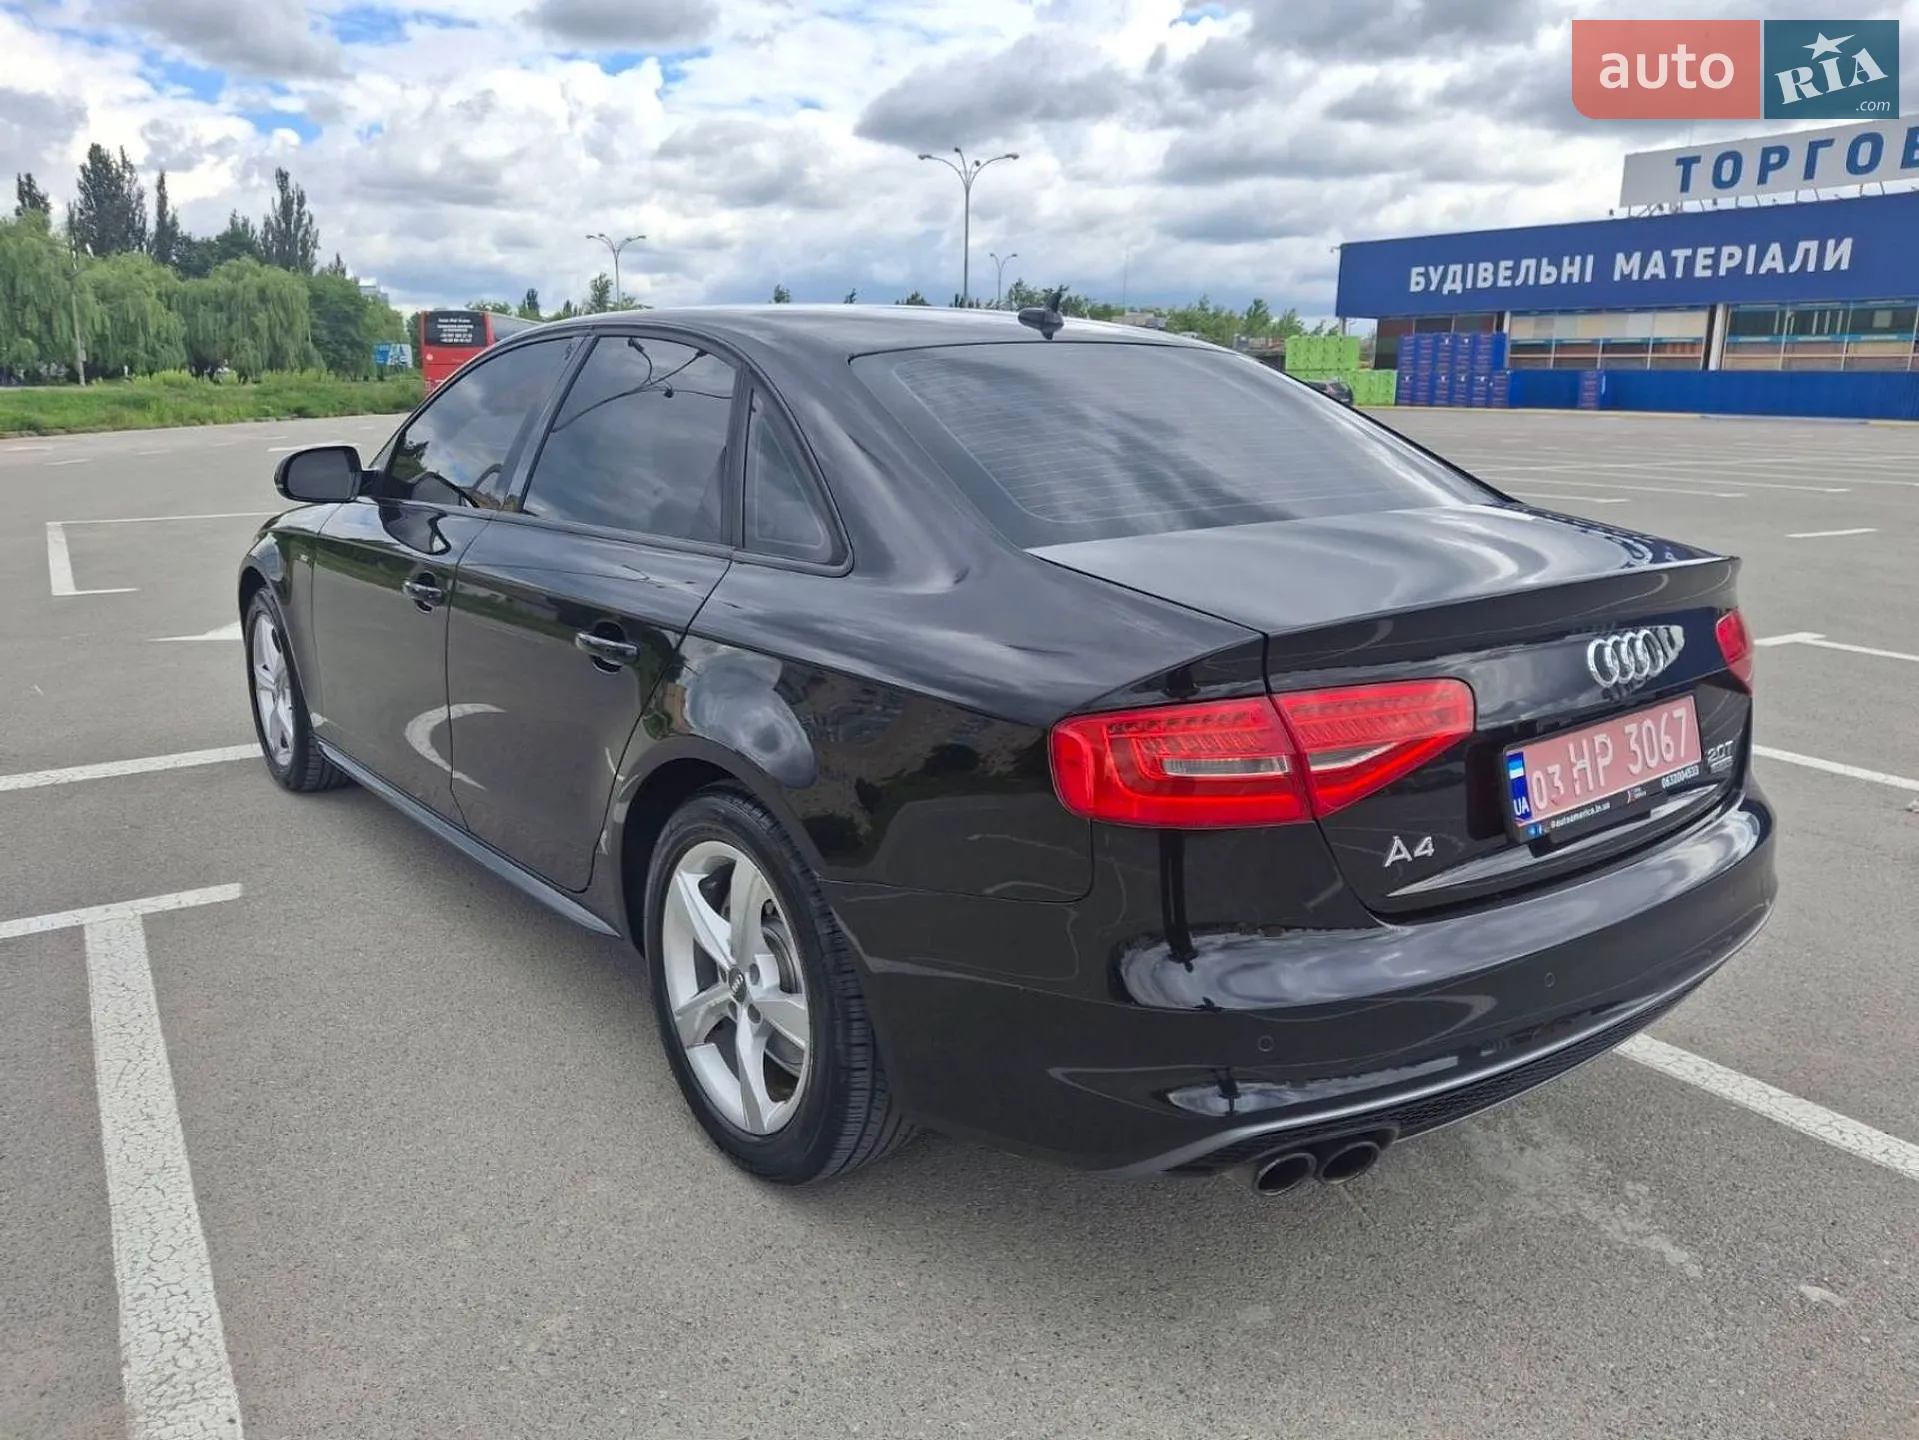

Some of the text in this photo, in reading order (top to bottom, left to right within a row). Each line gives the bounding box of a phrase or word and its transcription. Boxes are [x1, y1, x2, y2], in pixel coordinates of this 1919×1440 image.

[1409, 237, 1853, 294] БУДІВЕЛЬНІ МАТЕРІАЛИ
[1532, 707, 1688, 810] 03 HP 3067
[1513, 796, 1531, 816] UA
[1384, 835, 1435, 867] A4
